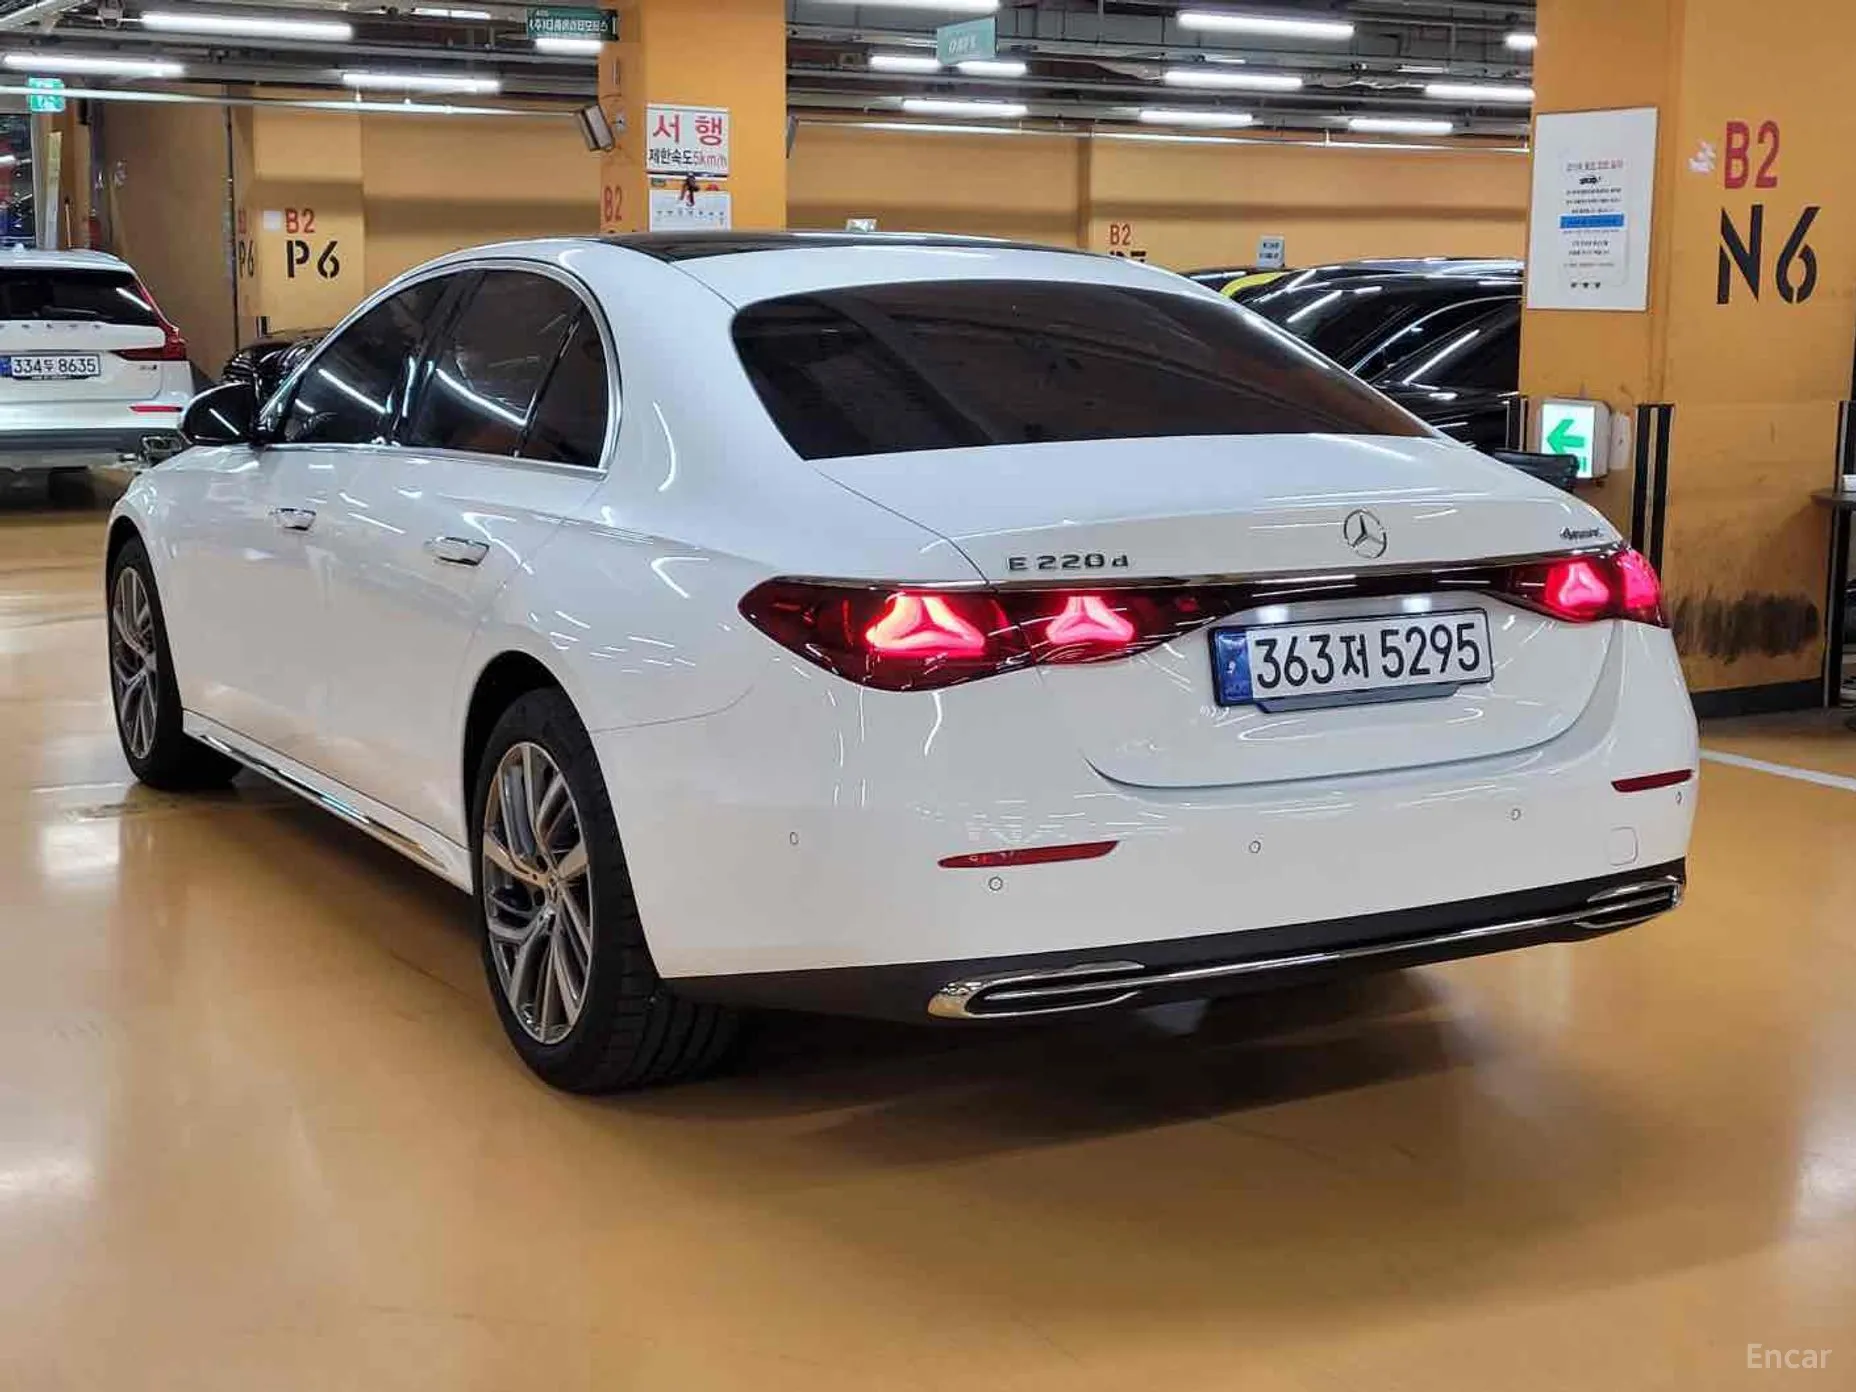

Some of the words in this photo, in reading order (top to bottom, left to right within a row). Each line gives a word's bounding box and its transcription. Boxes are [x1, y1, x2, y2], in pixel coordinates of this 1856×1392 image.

[652, 114, 680, 143] 서
[1724, 120, 1780, 189] B2
[285, 208, 315, 233] B2
[603, 185, 622, 222] B2
[1110, 224, 1131, 246] B2
[238, 240, 254, 279] P6
[286, 240, 340, 279] P6
[1717, 204, 1821, 304] N6
[58, 358, 96, 373] 8635
[1009, 557, 1028, 571] E
[1036, 553, 1105, 570] 220
[1255, 632, 1370, 690] 363저
[1380, 622, 1479, 678] 5295
